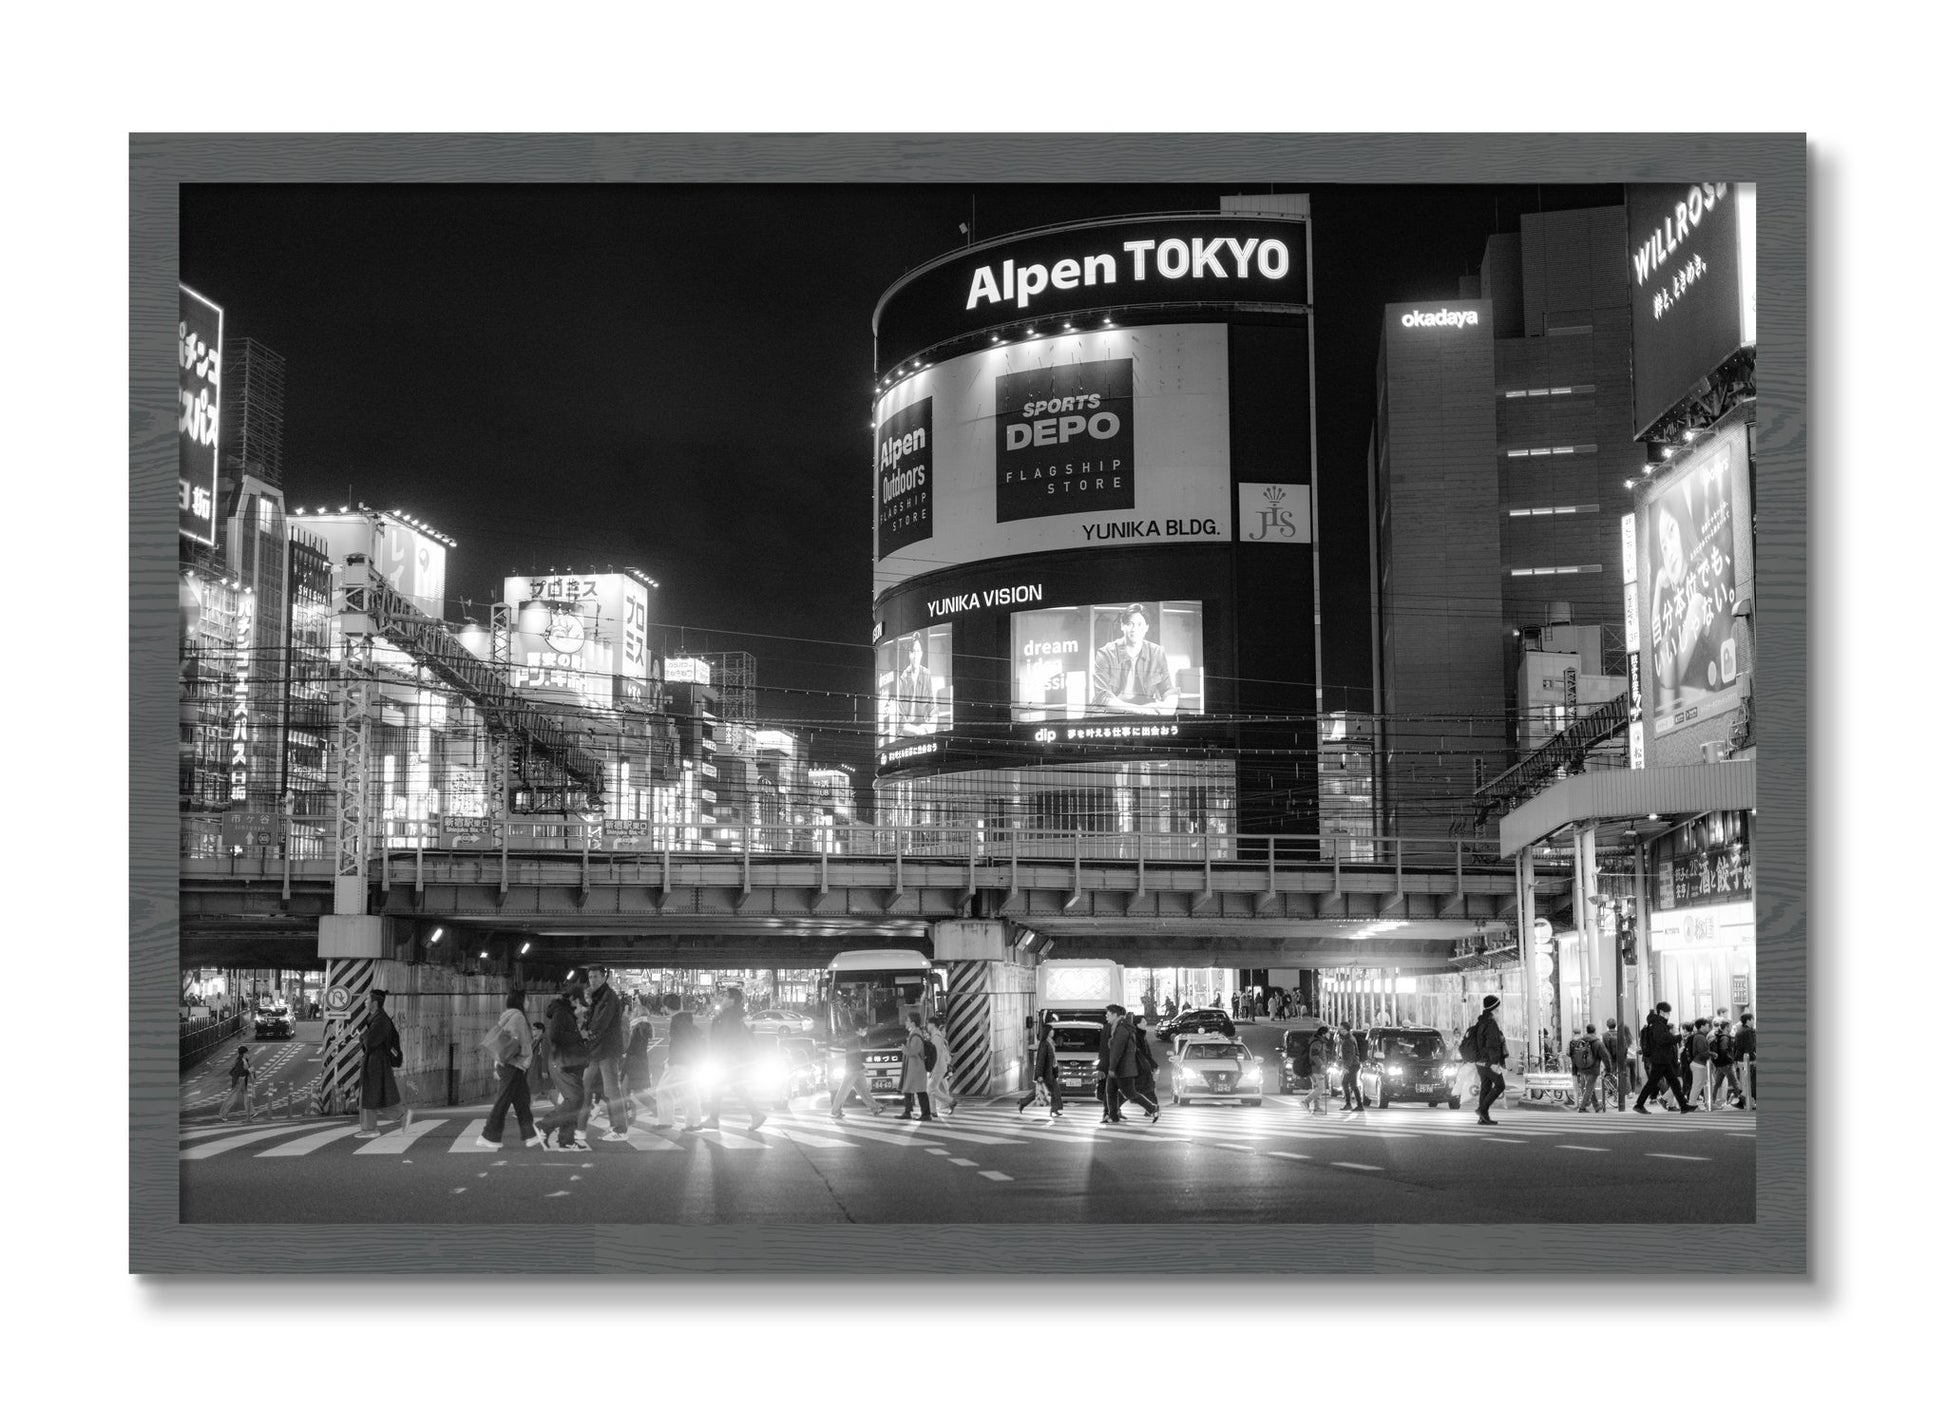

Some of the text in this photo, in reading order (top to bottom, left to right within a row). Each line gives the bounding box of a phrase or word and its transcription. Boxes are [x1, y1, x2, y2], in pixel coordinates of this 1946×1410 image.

[965, 237, 1291, 310] Alpen TOKYO
[1401, 308, 1479, 328] okadaya
[179, 387, 218, 448] スパス
[1022, 392, 1101, 418] SPORTS
[1005, 410, 1121, 451] DEPO
[879, 425, 926, 472] Alpen
[882, 463, 926, 504] Outdoors
[1005, 459, 1122, 484] FLAGSHIP
[1047, 477, 1122, 495] STORE
[879, 491, 928, 526] FLAGSHIP
[891, 510, 928, 532] STORE
[1082, 518, 1221, 541] YUNIKA BLDG.
[297, 584, 328, 605] SHISHA
[530, 578, 598, 599] プロミス
[927, 583, 1043, 618] YUNIKA VISION
[1651, 546, 1732, 648] 自分本位でも、
[1654, 582, 1736, 678] いいじゃない。
[1023, 639, 1079, 657] dream
[1034, 725, 1179, 743] dip 夢を叶える仕事に出会おう
[444, 817, 489, 828] 新宿駅東口
[605, 820, 648, 830] 新宿駅東口
